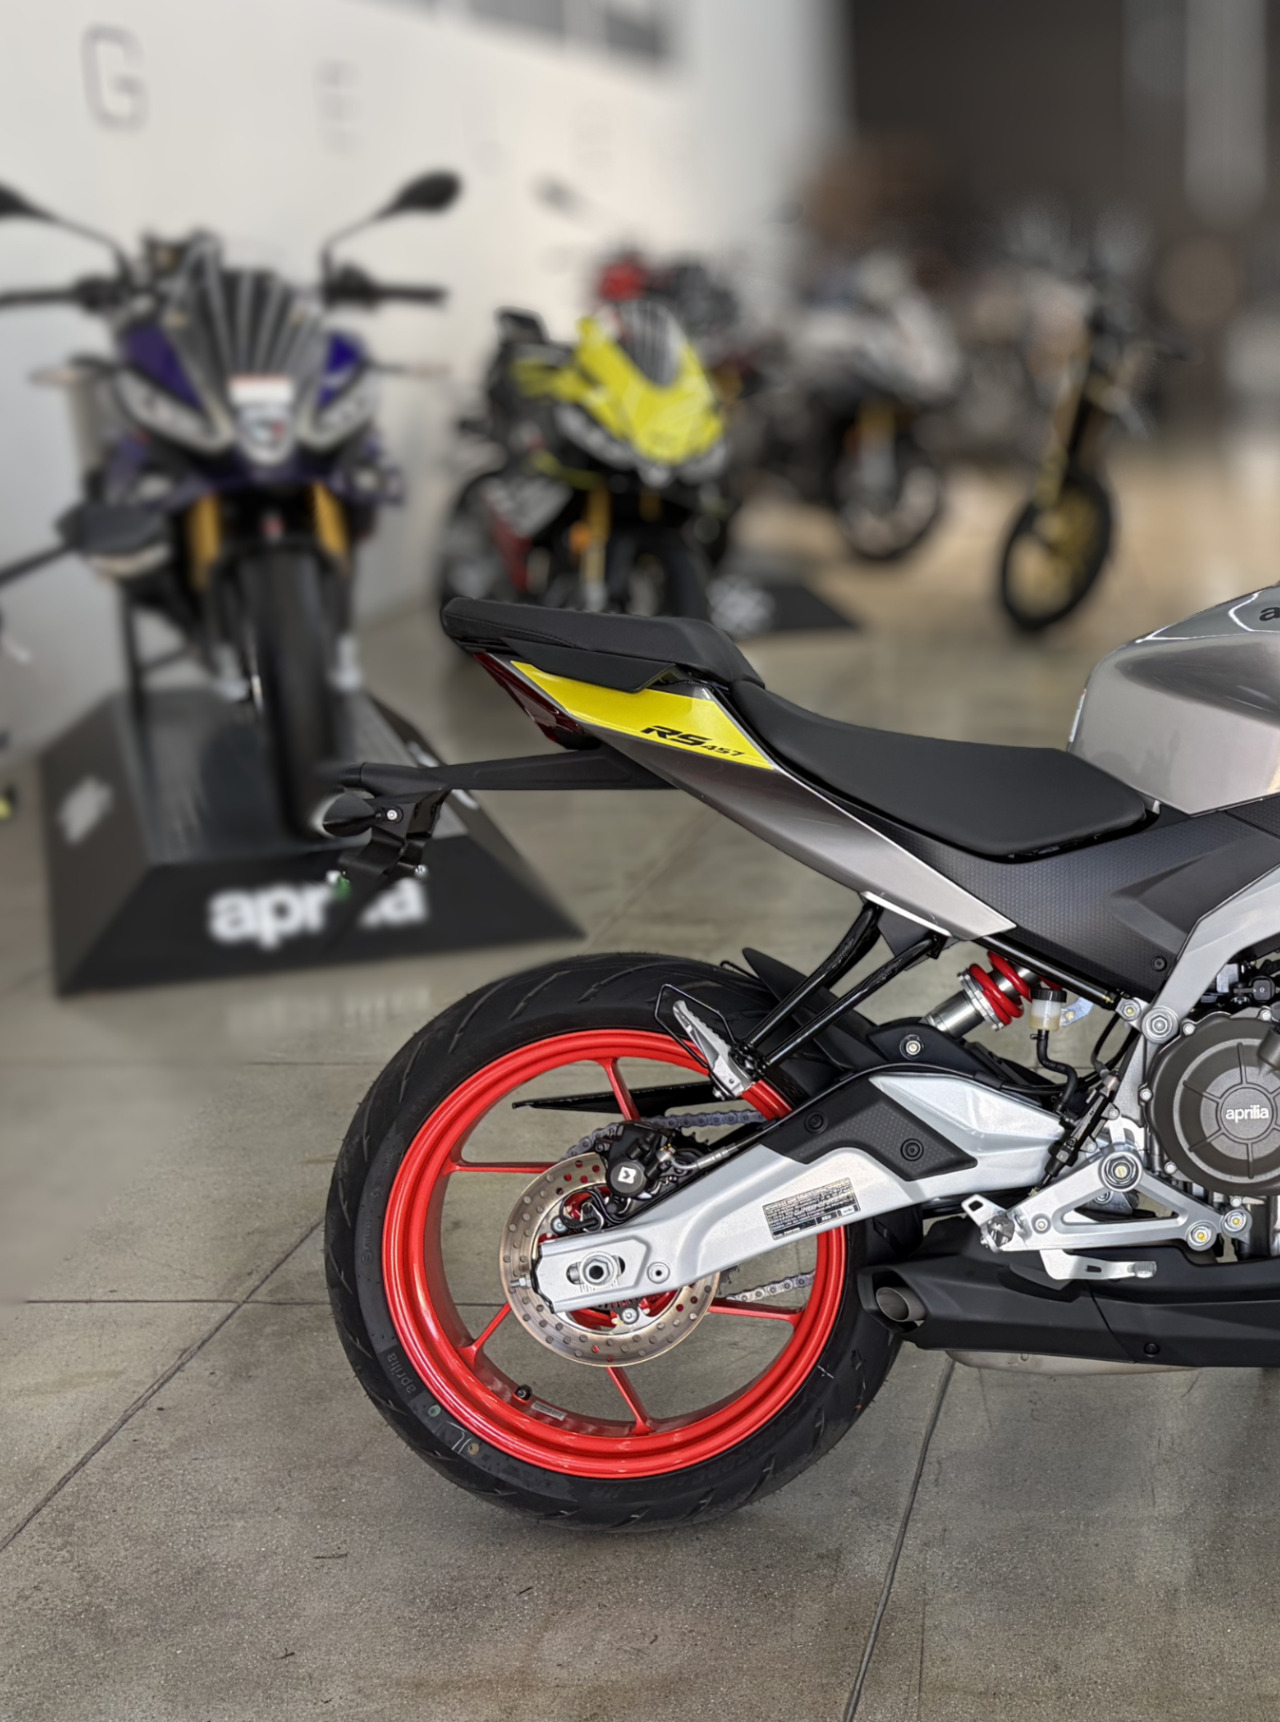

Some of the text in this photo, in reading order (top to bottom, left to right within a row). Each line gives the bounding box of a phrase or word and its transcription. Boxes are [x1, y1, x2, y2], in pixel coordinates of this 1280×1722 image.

[640, 725, 745, 756] RS 457
[208, 869, 428, 948] apra
[1225, 1104, 1270, 1123] aprilia
[387, 1353, 416, 1394] aprilia
